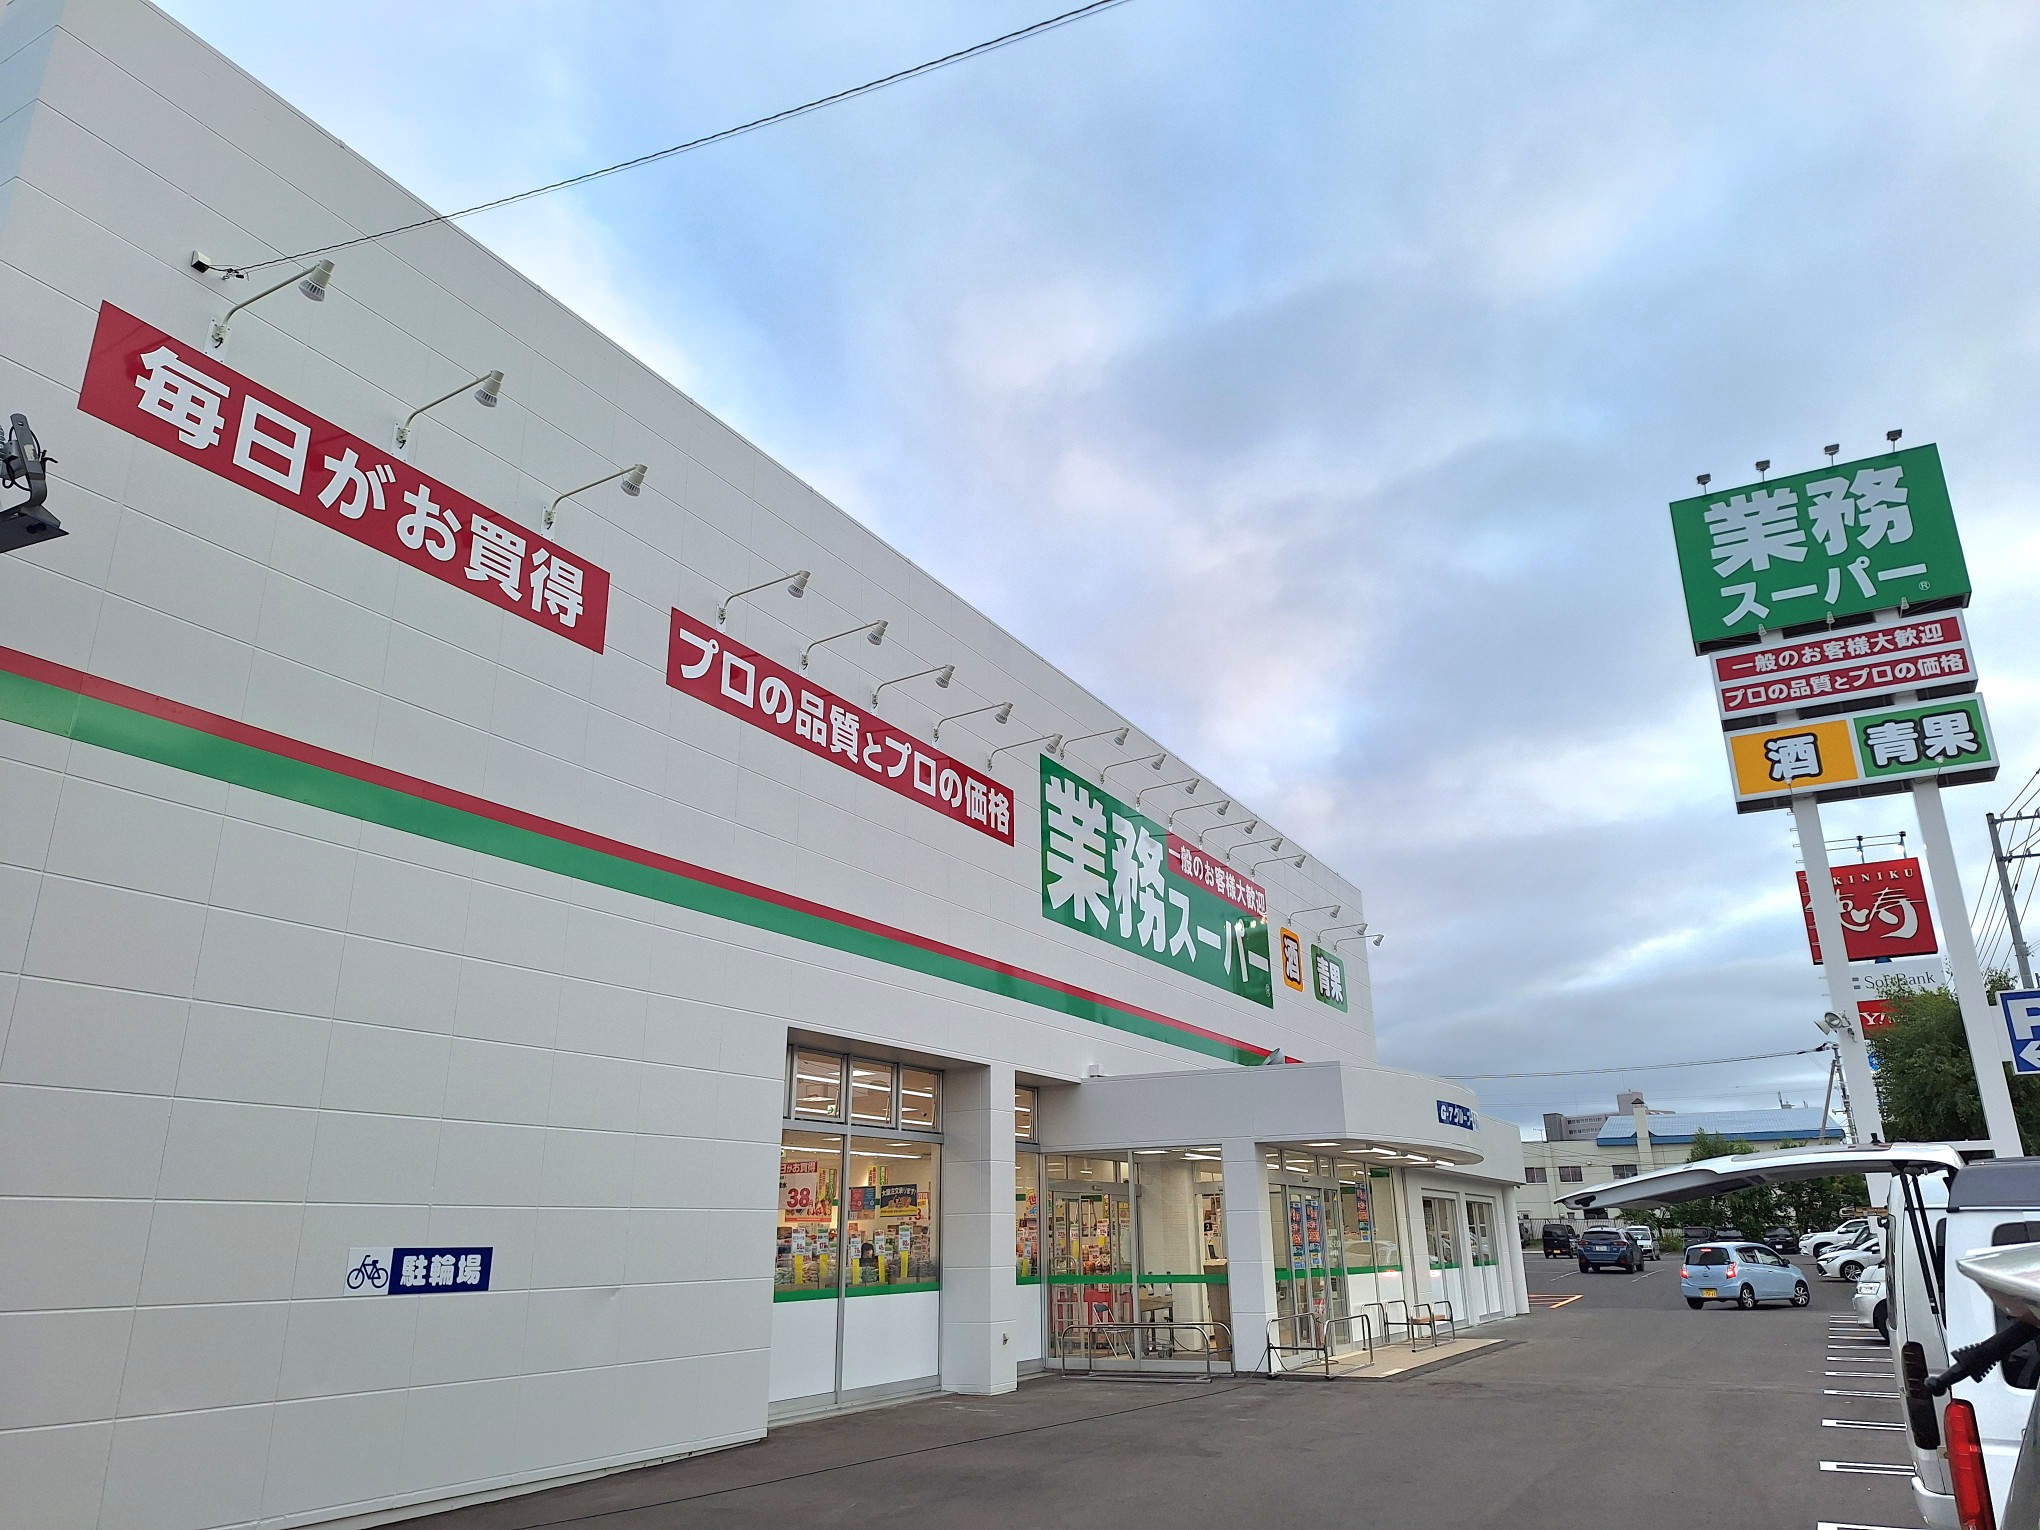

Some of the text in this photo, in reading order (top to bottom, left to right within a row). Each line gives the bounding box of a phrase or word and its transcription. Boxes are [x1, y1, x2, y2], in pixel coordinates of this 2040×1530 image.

[134, 346, 584, 629] 毎日がお買得
[1703, 465, 1914, 578] 業務
[1720, 556, 1928, 627] スーパー
[1731, 623, 1945, 673] 一般のお客様大歓迎
[1725, 653, 1965, 709] プロの品質とプロの価格
[679, 627, 1010, 836] プロの品質とプロの価格
[1767, 733, 1821, 781] 酒
[1867, 711, 1979, 767] 青果
[1168, 845, 1269, 917] 一般のお客様大歓迎
[1283, 936, 1302, 985] 酒
[1315, 953, 1345, 1003] 青果
[399, 1253, 482, 1287] 駐輪場
